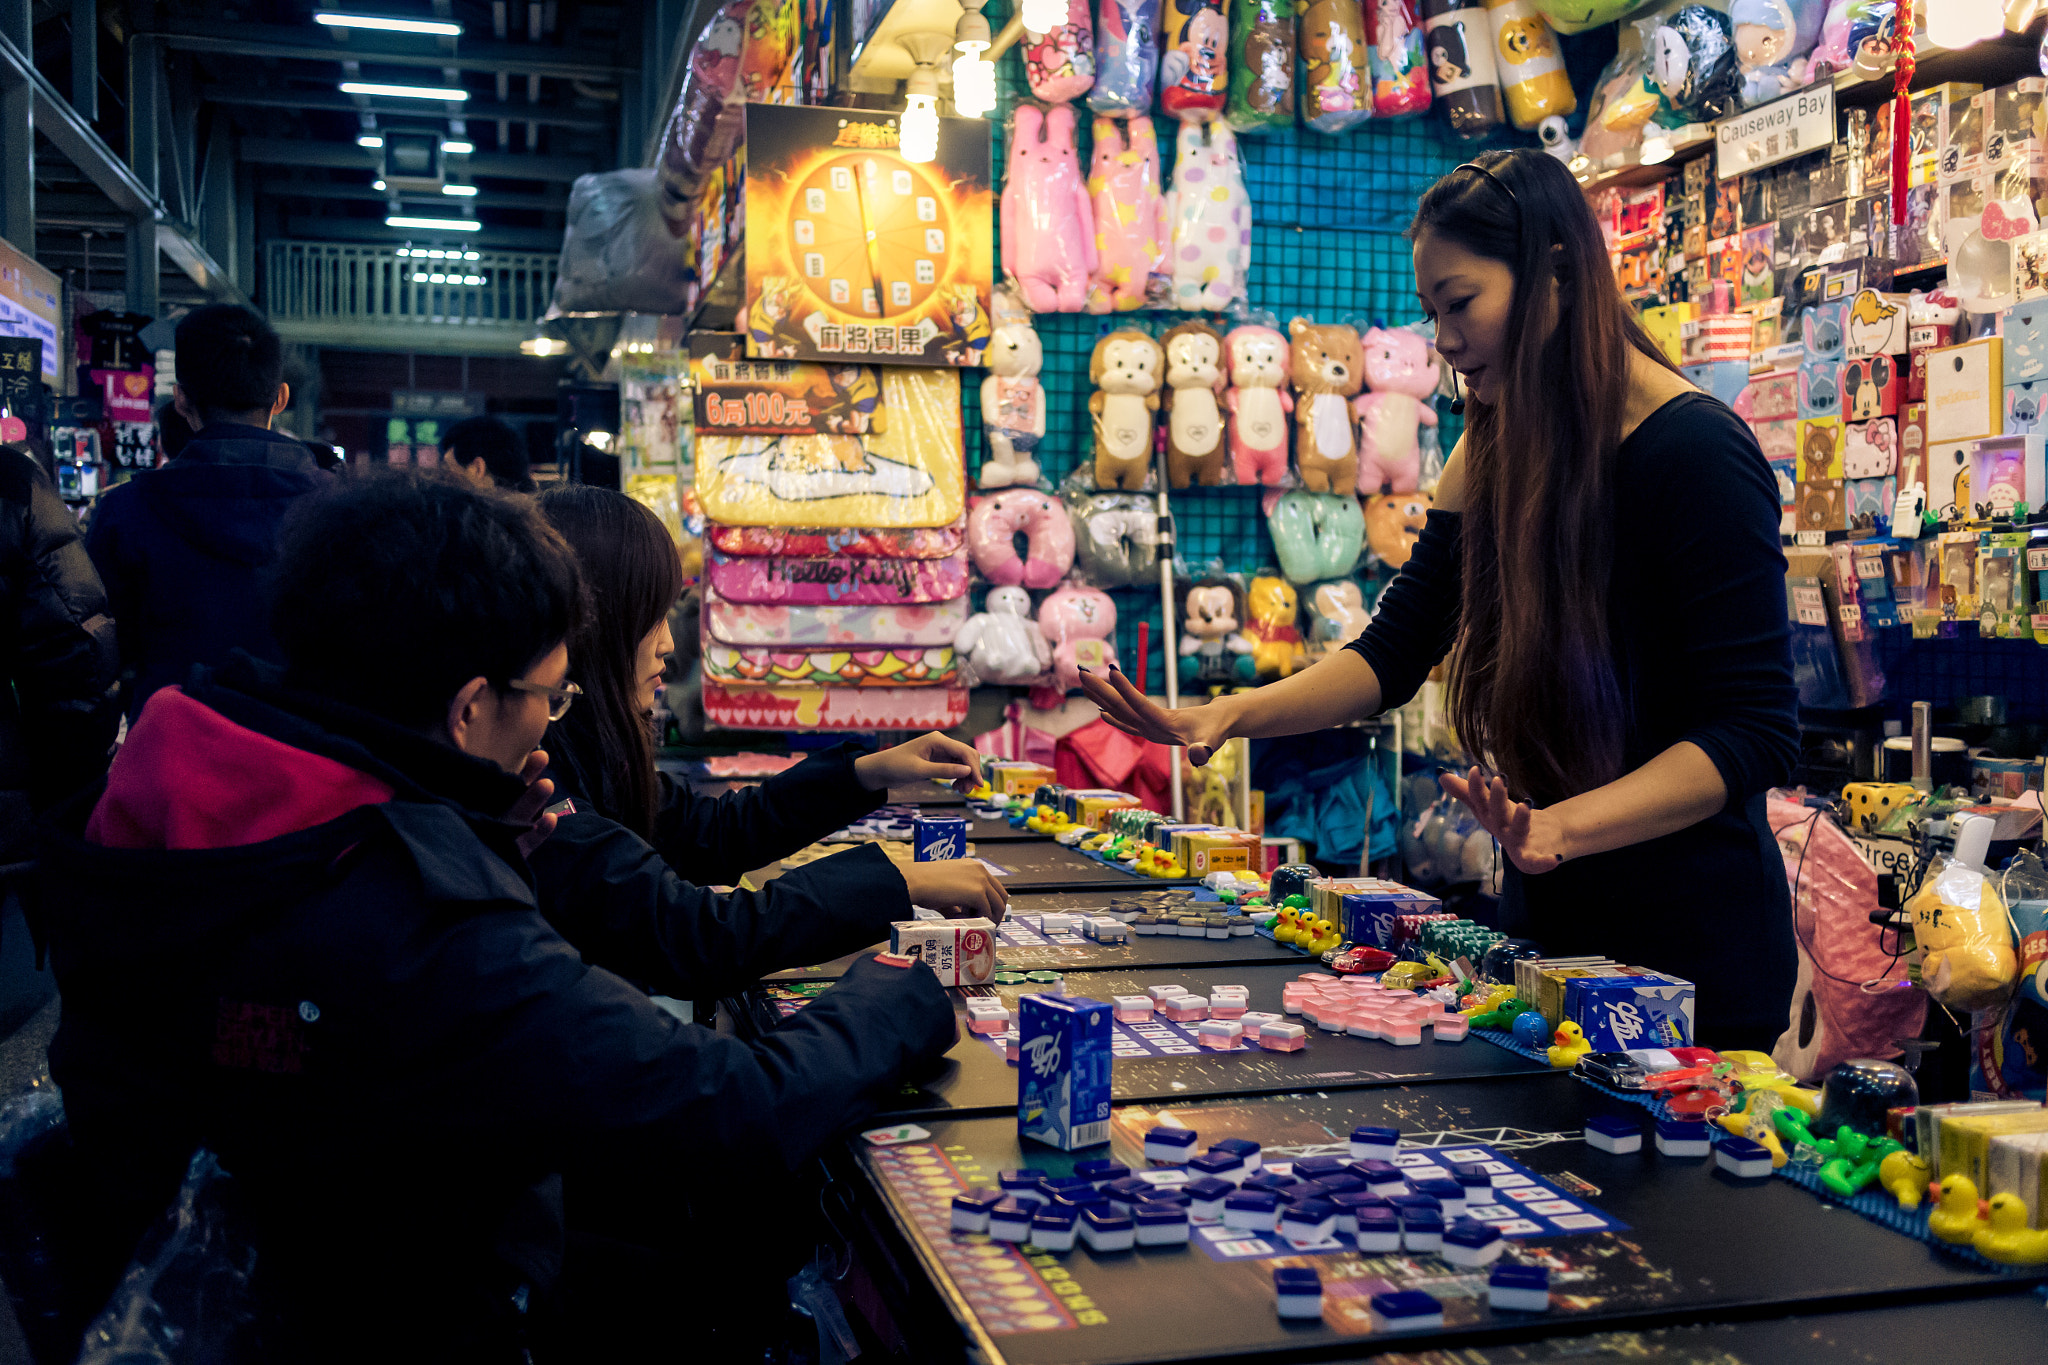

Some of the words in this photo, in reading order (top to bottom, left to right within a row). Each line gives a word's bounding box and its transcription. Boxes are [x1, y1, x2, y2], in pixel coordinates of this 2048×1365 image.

[1720, 105, 1794, 144] Causeway
[1798, 93, 1827, 117] Bay
[817, 324, 925, 355] 麻將賓果
[713, 362, 792, 383] 麻將賓果
[706, 392, 811, 427] 6局100元
[767, 558, 848, 584] Hello
[941, 945, 953, 970] 奶茶
